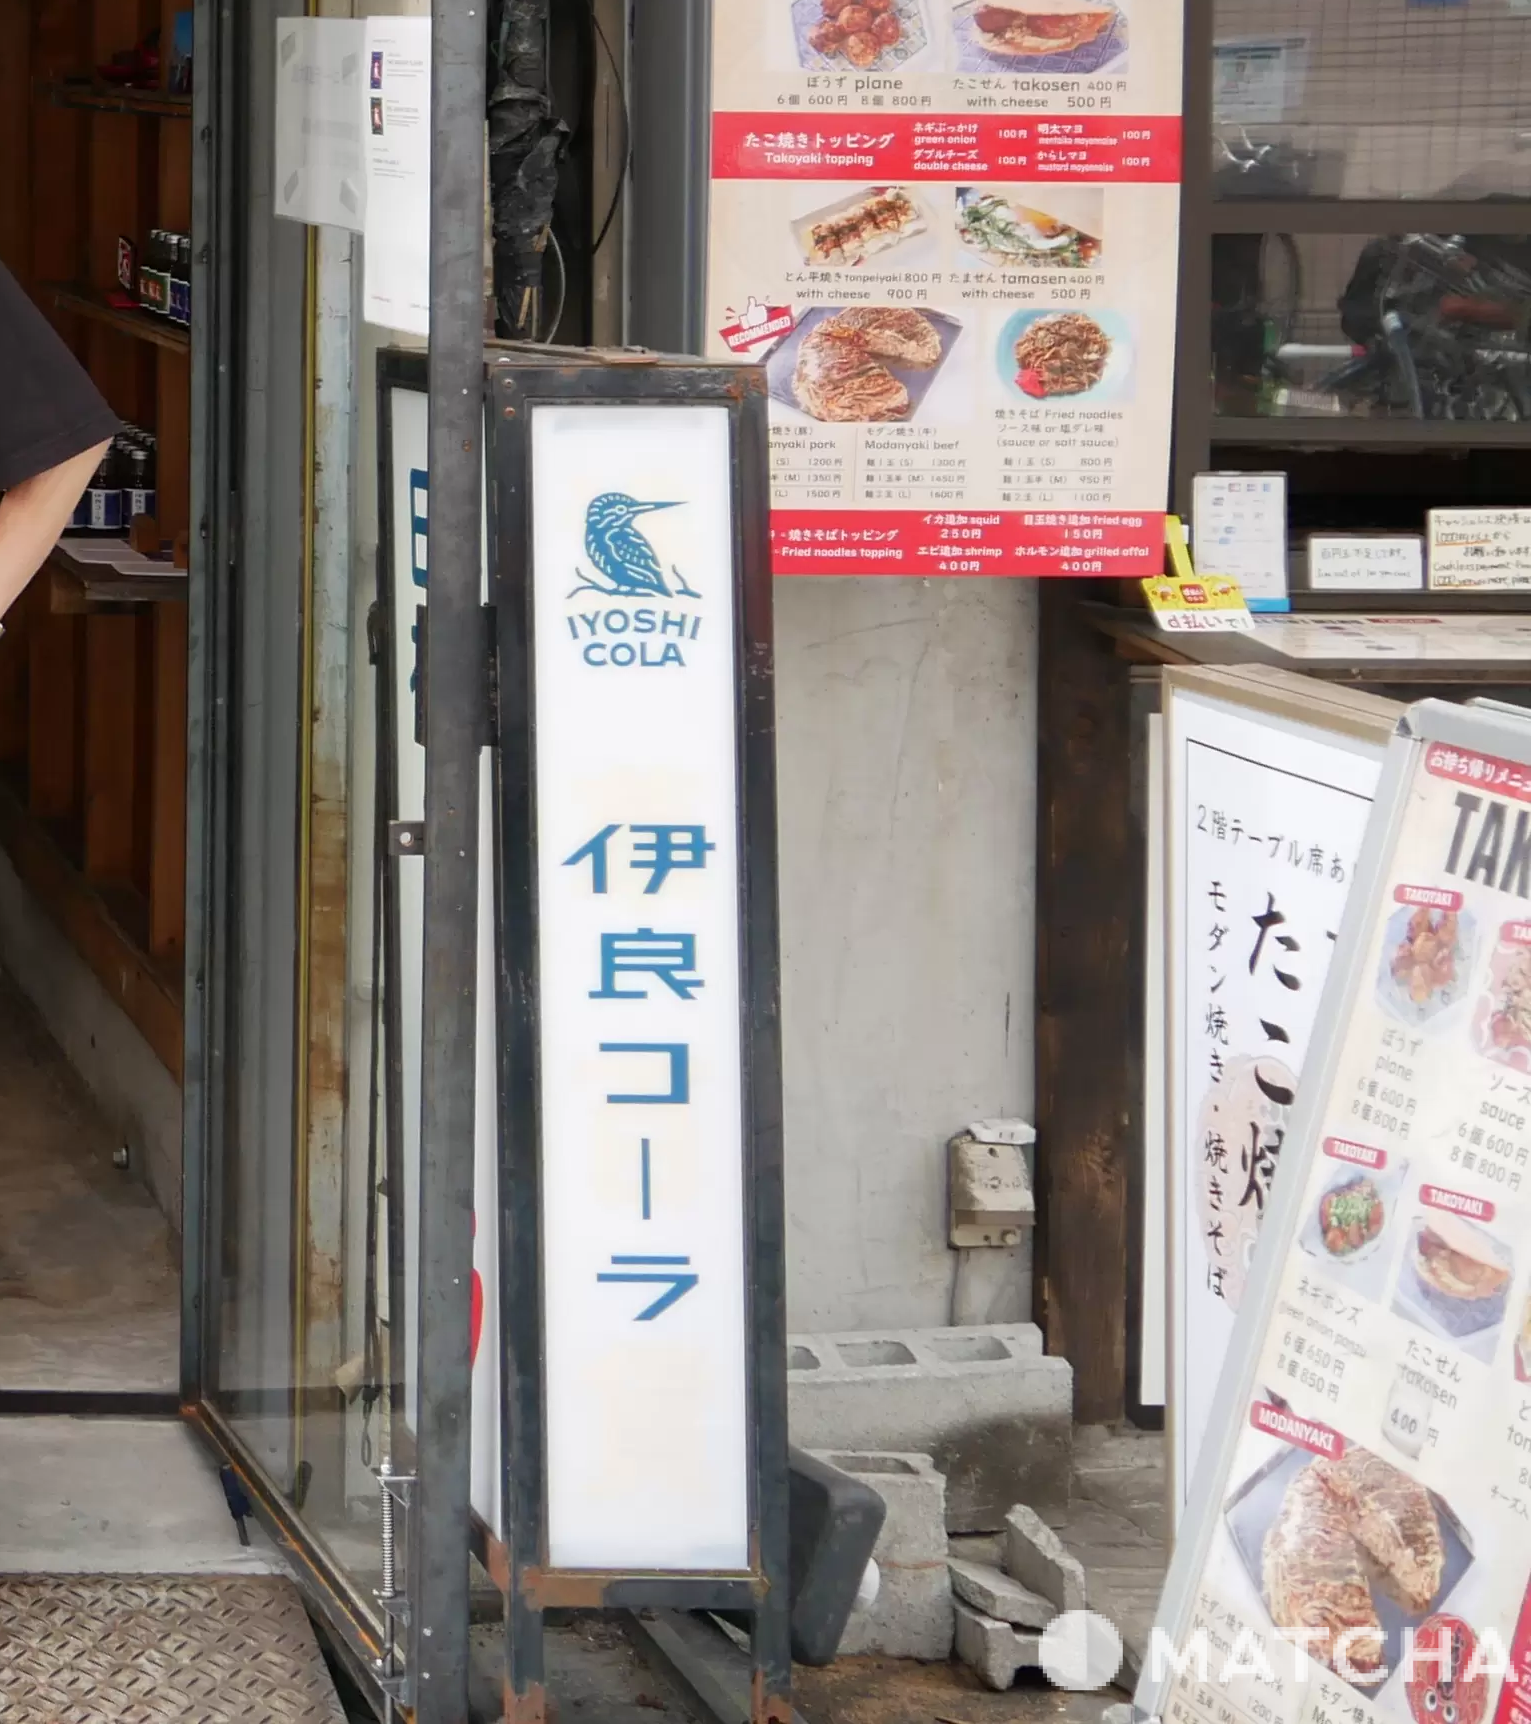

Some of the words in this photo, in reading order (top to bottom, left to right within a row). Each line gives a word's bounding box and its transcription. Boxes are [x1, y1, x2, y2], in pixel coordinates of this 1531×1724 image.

[807, 76, 848, 88] ぼうず
[855, 77, 903, 92] plane
[952, 78, 1006, 90] たこせん
[1013, 79, 1080, 92] takosen
[1087, 81, 1127, 92] 400円
[966, 96, 996, 108] with
[1001, 96, 1049, 108] cheese
[1067, 96, 1112, 108] 500円
[913, 122, 978, 134] ネギぶっかけ
[1037, 123, 1084, 134] 明太マヨ
[744, 131, 894, 149] たこ焼きトッピング
[914, 136, 945, 145] green
[947, 135, 976, 144] onion
[764, 152, 821, 165] Takoyaki
[825, 153, 874, 167] topping
[913, 149, 978, 160] ダブルチーズ
[913, 161, 950, 171] double
[952, 162, 989, 171] cheese
[949, 273, 996, 283] たません
[1002, 273, 1066, 285] tamasen
[796, 288, 823, 299] with
[827, 288, 870, 299] cheese
[887, 288, 927, 300] 900円
[961, 289, 988, 299] with
[992, 289, 1035, 299] cheese
[1051, 289, 1091, 300] 500円
[1045, 410, 1075, 419] Fried
[1078, 410, 1123, 419] noodles
[864, 440, 929, 451] Modanyaki
[933, 440, 959, 450] beef
[923, 514, 967, 525] イカ追加
[970, 514, 1000, 526] squid
[1093, 515, 1120, 525] fried
[1121, 516, 1142, 527] egg
[940, 528, 981, 539] 250円
[782, 546, 811, 557] Fried
[814, 547, 857, 557] noodles
[860, 547, 903, 559] topping
[917, 546, 963, 557] エビ追加
[965, 546, 1002, 558] shrimp
[1015, 546, 1082, 557] ホルモン追加
[1084, 546, 1119, 557] grilled
[1122, 546, 1149, 556] offal
[939, 561, 980, 571] 400円
[565, 607, 703, 642] IYOSHI
[582, 641, 686, 668] COLA
[561, 823, 716, 1323] 伊良コーラ
[1375, 1054, 1414, 1082] plane
[1204, 879, 1231, 1301] モダン焼き・焼きそば
[1479, 1100, 1526, 1132] sauce
[1405, 1337, 1462, 1384] たこせん
[1396, 1361, 1459, 1410] takosen
[1258, 1407, 1336, 1451] MODANYAKI
